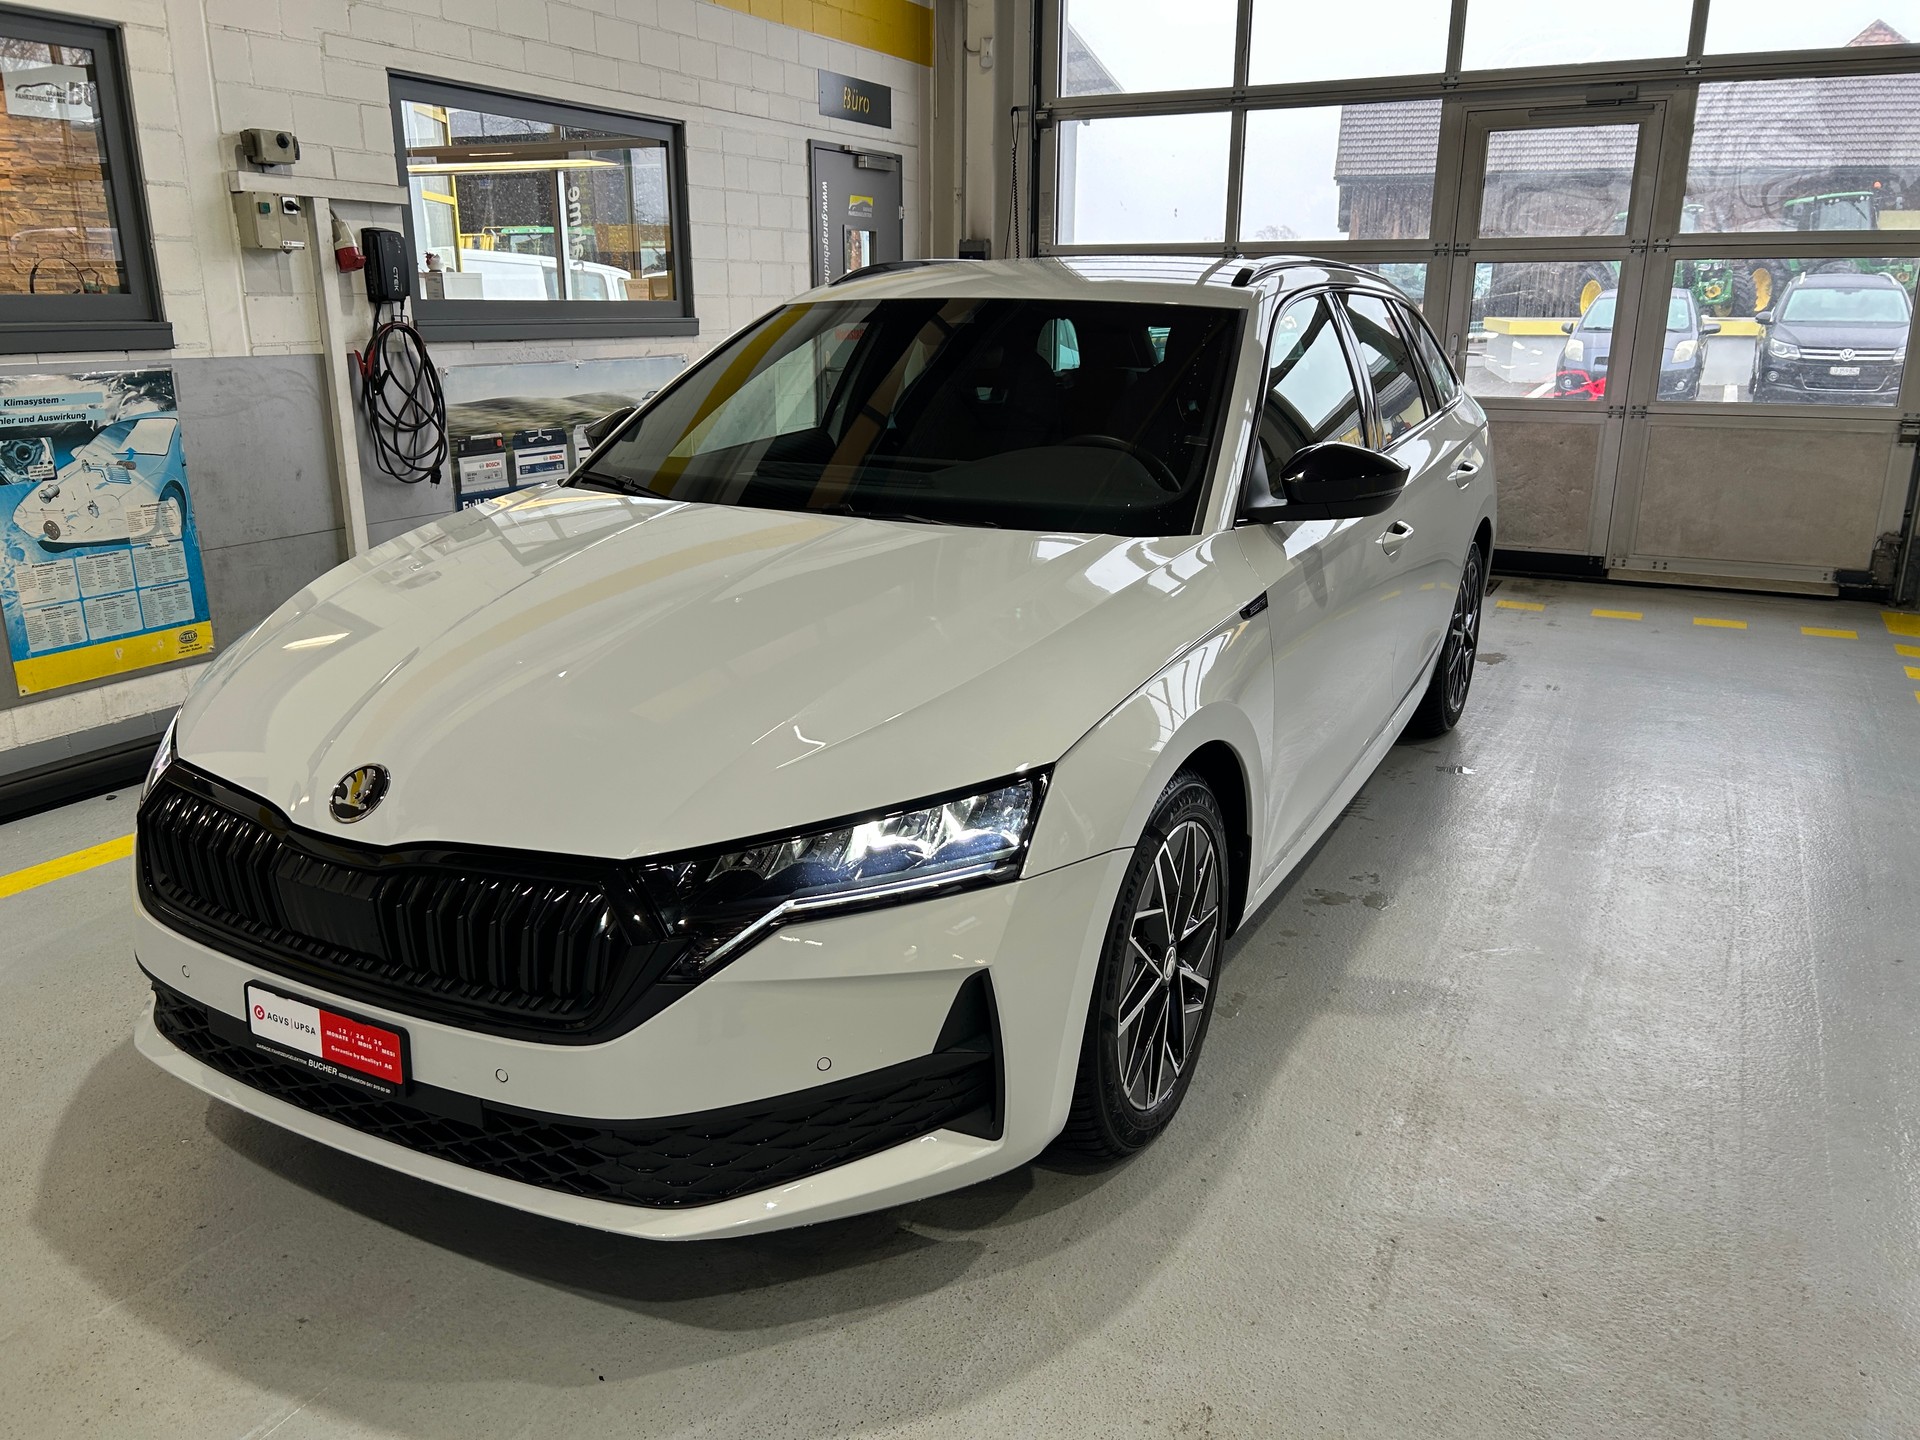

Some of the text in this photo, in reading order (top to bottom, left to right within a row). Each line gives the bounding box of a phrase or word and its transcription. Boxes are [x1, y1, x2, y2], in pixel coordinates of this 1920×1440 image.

[46, 90, 67, 98] GARAGE
[843, 86, 870, 114] Büro
[392, 266, 400, 292] CTEK
[3, 397, 60, 407] Klimasystem
[18, 415, 35, 423] und
[37, 412, 87, 423] Auswirkung
[1106, 859, 1144, 1001] SEMPERIT
[267, 1012, 316, 1035] AGVS UPSA
[338, 1027, 347, 1035] 12
[326, 1030, 396, 1058] MONATE MOIS MESI
[331, 1045, 353, 1056] Garantie
[353, 1052, 360, 1060] by
[308, 1059, 338, 1076] BUCHER
